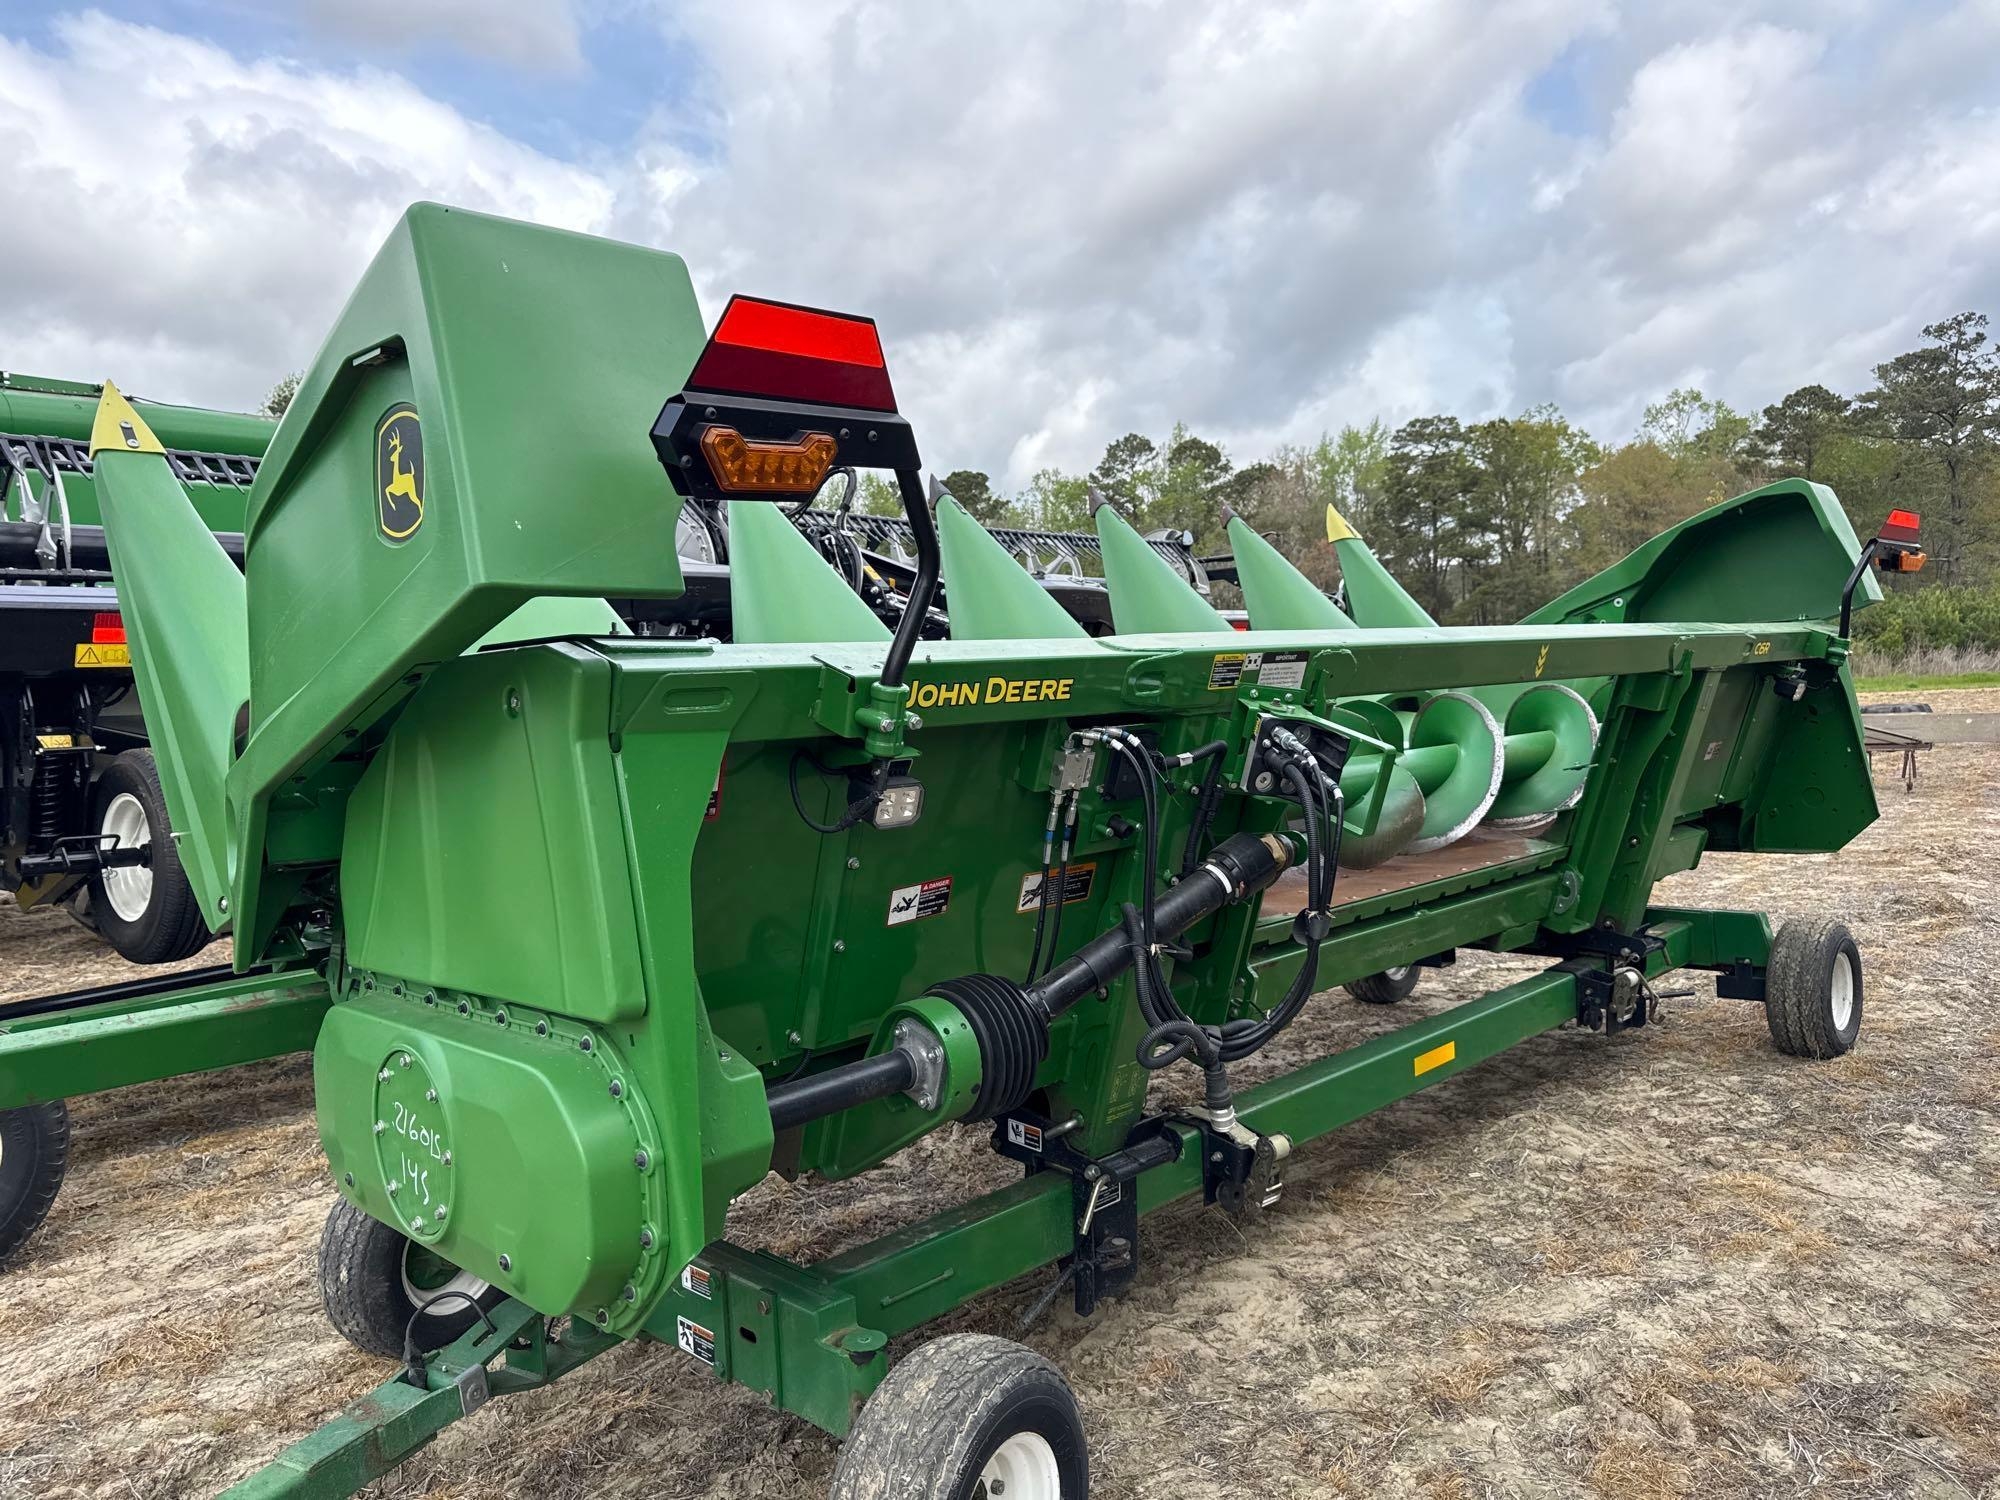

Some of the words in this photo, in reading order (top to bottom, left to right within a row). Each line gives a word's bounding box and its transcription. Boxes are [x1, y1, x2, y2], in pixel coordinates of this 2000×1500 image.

[1754, 641, 1771, 656] C6R
[905, 680, 981, 709] JOHN
[984, 677, 1074, 704] DEERE
[929, 879, 950, 890] DANGER
